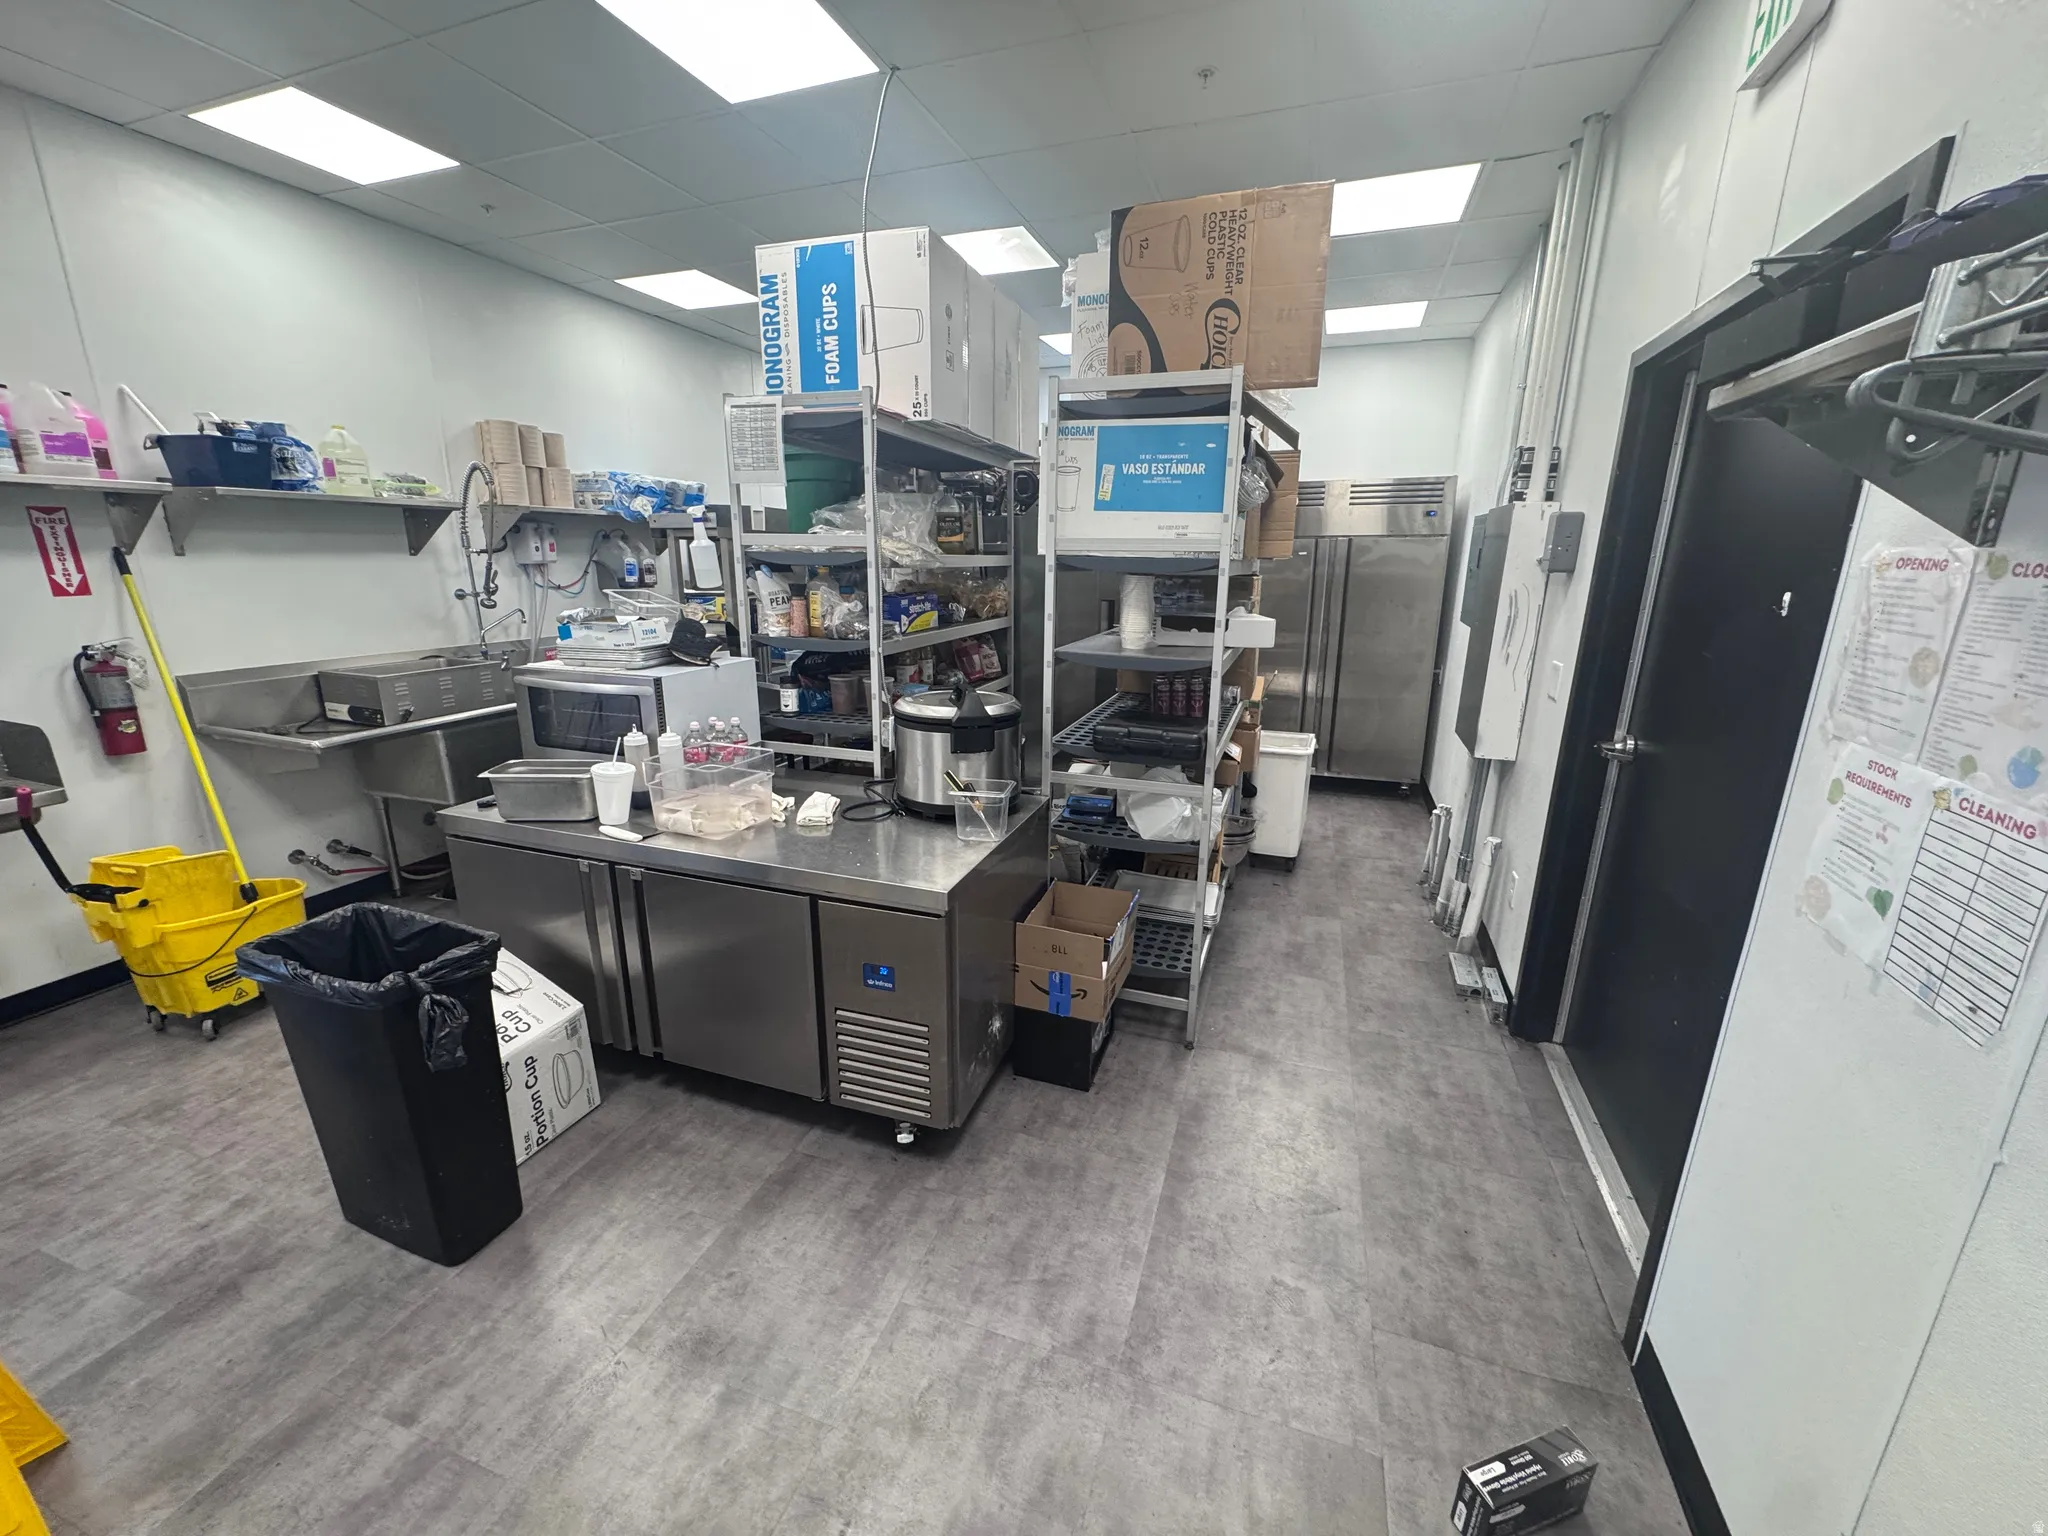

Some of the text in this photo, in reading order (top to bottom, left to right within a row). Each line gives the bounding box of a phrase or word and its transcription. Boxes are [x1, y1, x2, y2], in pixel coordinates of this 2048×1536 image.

[1238, 207, 1247, 221] 12
[1205, 212, 1217, 281] COLD CUPS
[1216, 211, 1227, 260] PLASTIC
[1224, 209, 1237, 296] HEAVYWEIGHT
[1235, 247, 1246, 285] CLEAR
[782, 272, 791, 338] DISPOSABLES
[760, 273, 785, 395] ONOGRAM
[821, 282, 840, 385] FOAM CUPS
[1077, 320, 1105, 339] Foam
[912, 401, 922, 418] 25
[1122, 459, 1206, 474] VASO ESTÁNDAR
[34, 516, 66, 525] FIRE
[48, 525, 74, 588] EXTINGUISHER
[1895, 557, 1949, 572] OPENING
[1867, 760, 1899, 780] STOCK
[1845, 770, 1913, 809] REQUIREMENTS
[1958, 797, 2038, 840] CLEANING
[502, 1010, 531, 1033] Cup
[524, 1055, 549, 1147] Portion Cup
[1480, 1466, 1497, 1478] Large
